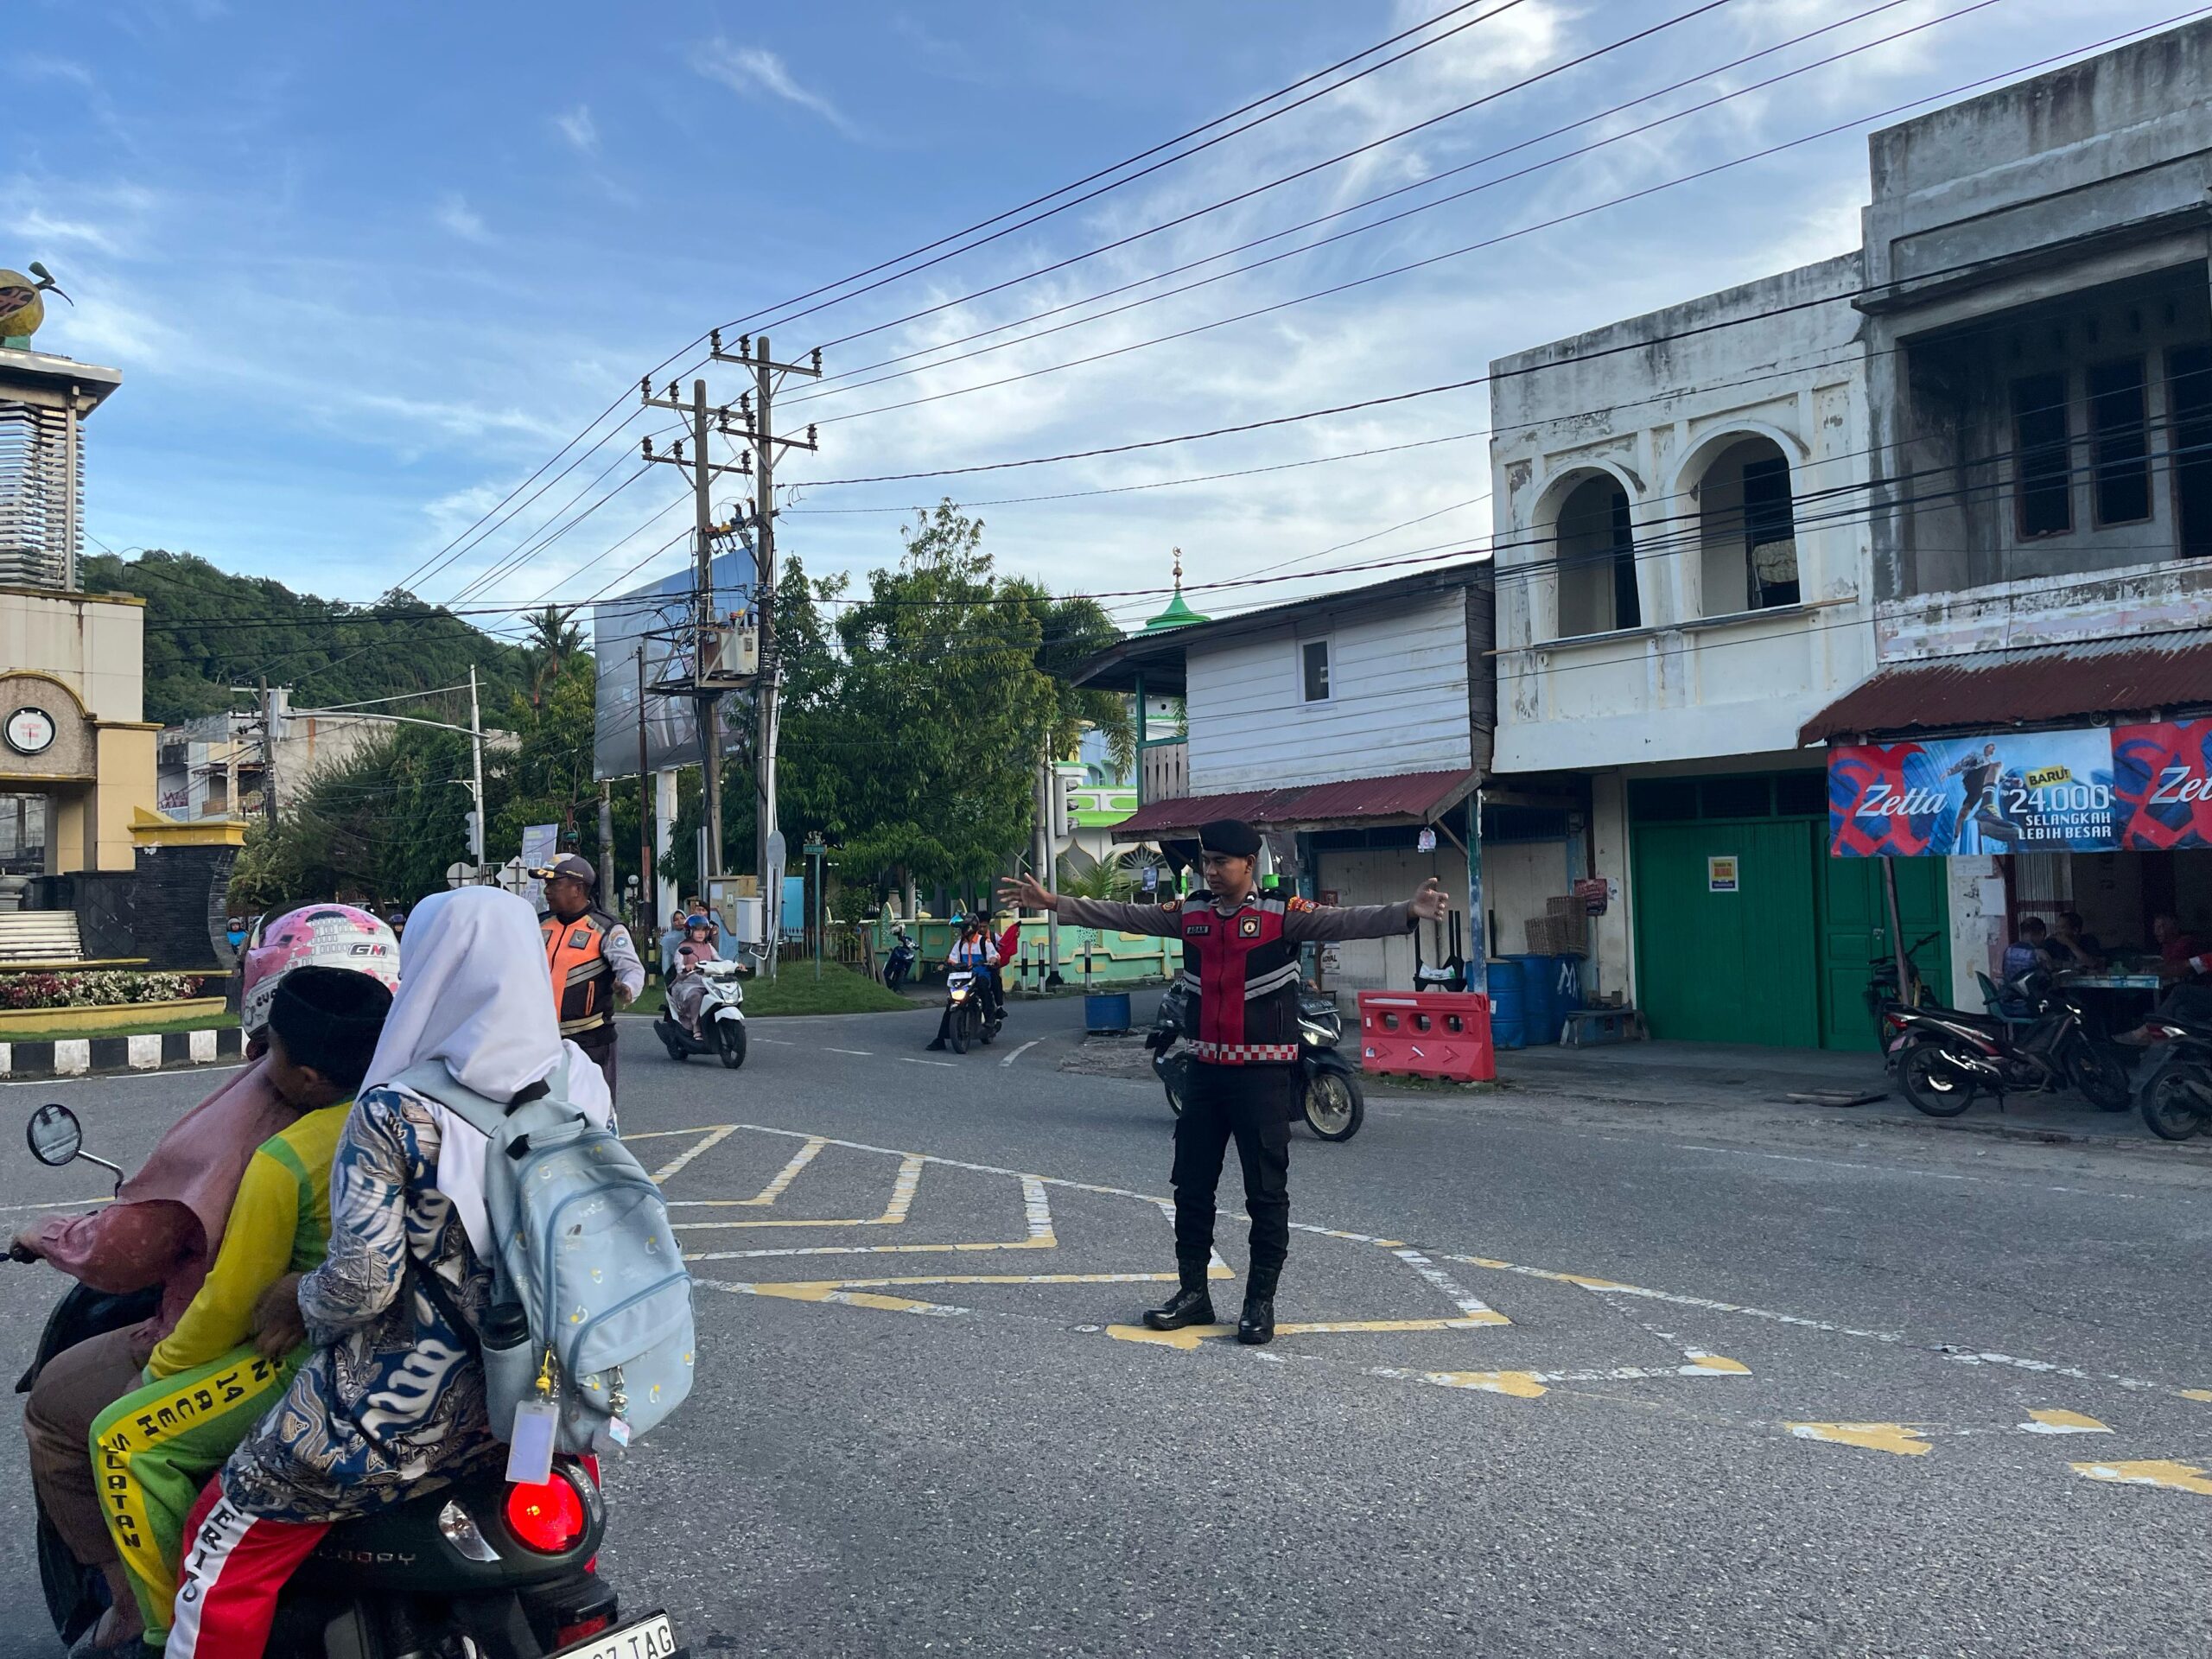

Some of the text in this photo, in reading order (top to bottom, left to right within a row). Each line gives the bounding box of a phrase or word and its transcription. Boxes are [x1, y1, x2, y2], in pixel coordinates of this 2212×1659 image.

[2029, 769, 2069, 786] BARU!
[1855, 785, 1948, 817] Zetta
[2009, 785, 2110, 813] 24.000
[2018, 826, 2112, 840] LEBIH BESAR
[2025, 812, 2111, 827] SELANGKAH
[351, 944, 386, 957] GM
[216, 1372, 245, 1403] 14
[137, 1389, 213, 1436] ACEH
[105, 1433, 141, 1548] SLATAN
[628, 1625, 671, 1659] TAG
